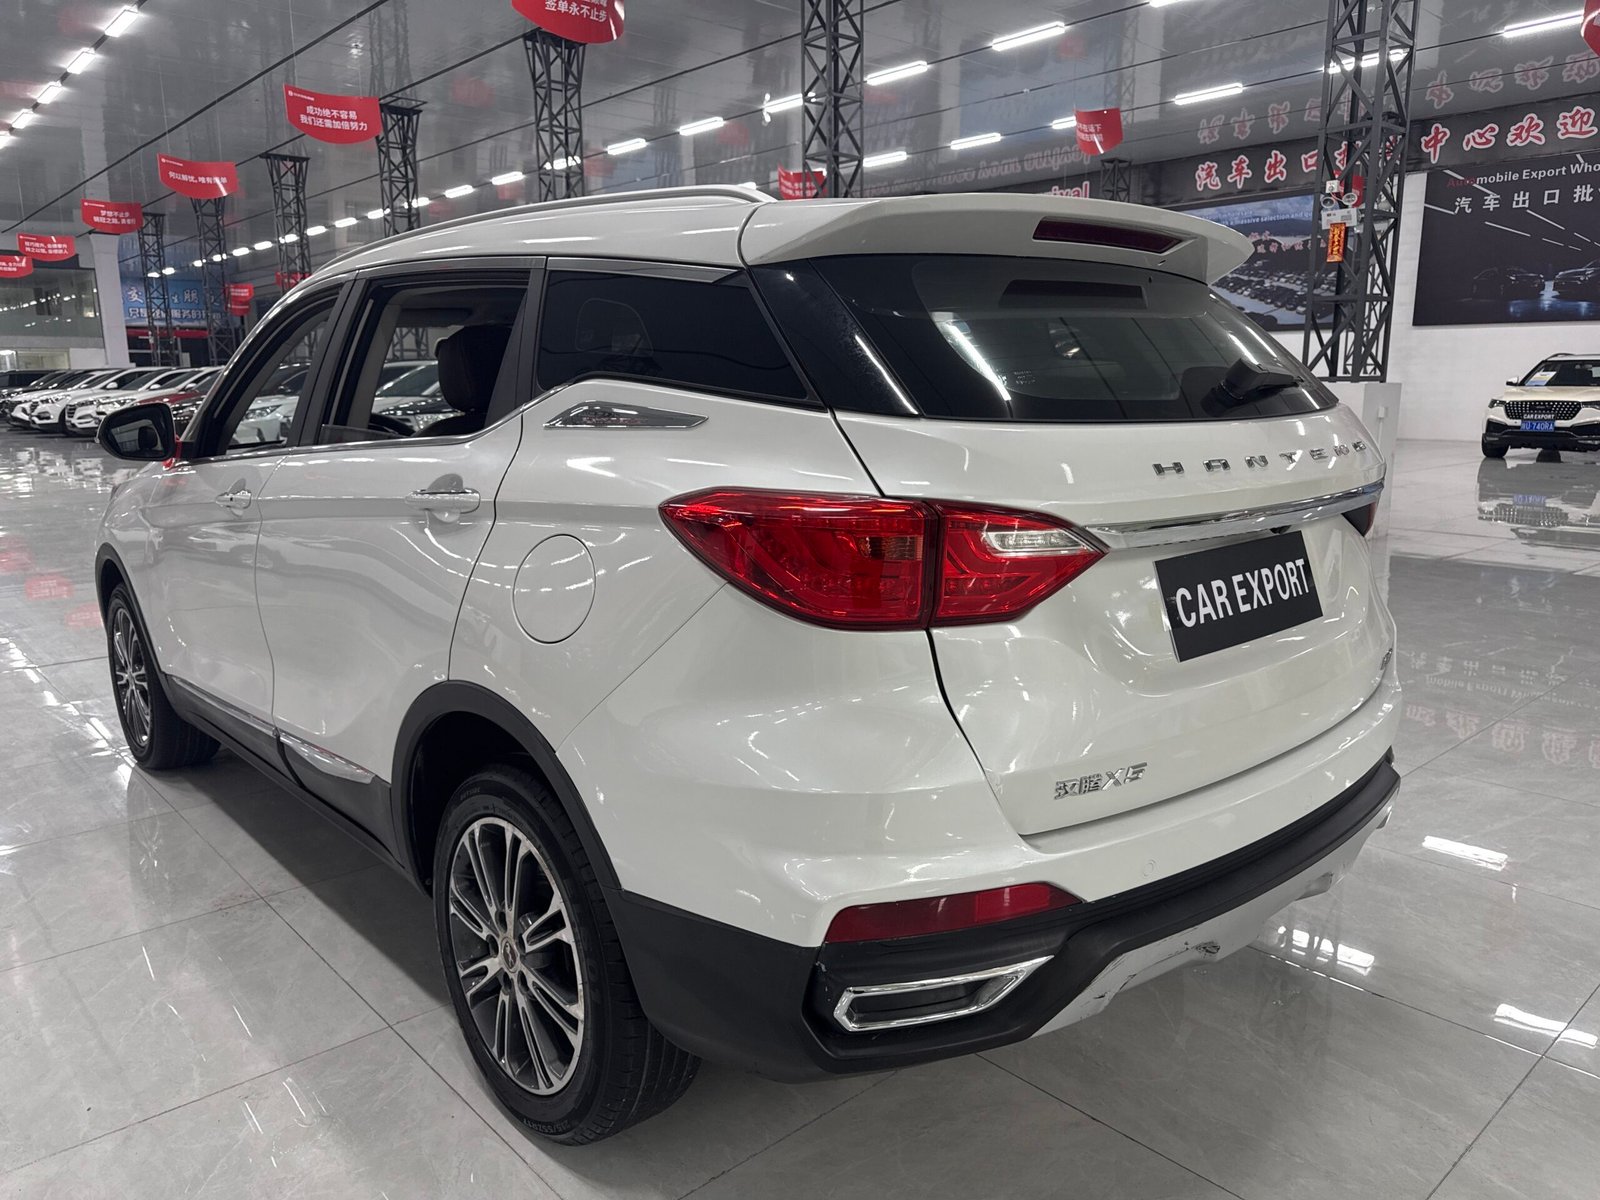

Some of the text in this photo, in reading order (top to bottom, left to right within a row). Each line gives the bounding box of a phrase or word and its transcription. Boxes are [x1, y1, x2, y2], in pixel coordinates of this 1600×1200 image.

[545, 0, 607, 22] 签单永不止步
[306, 105, 358, 120] 成功绝不容易
[300, 114, 368, 131] 我们还需加倍努力
[1522, 166, 1567, 180] Export
[1454, 184, 1600, 214] 汽车出口批
[1260, 213, 1290, 222] selection
[1152, 440, 1367, 476] HANTENG
[1175, 558, 1309, 628] CAR EXPORT
